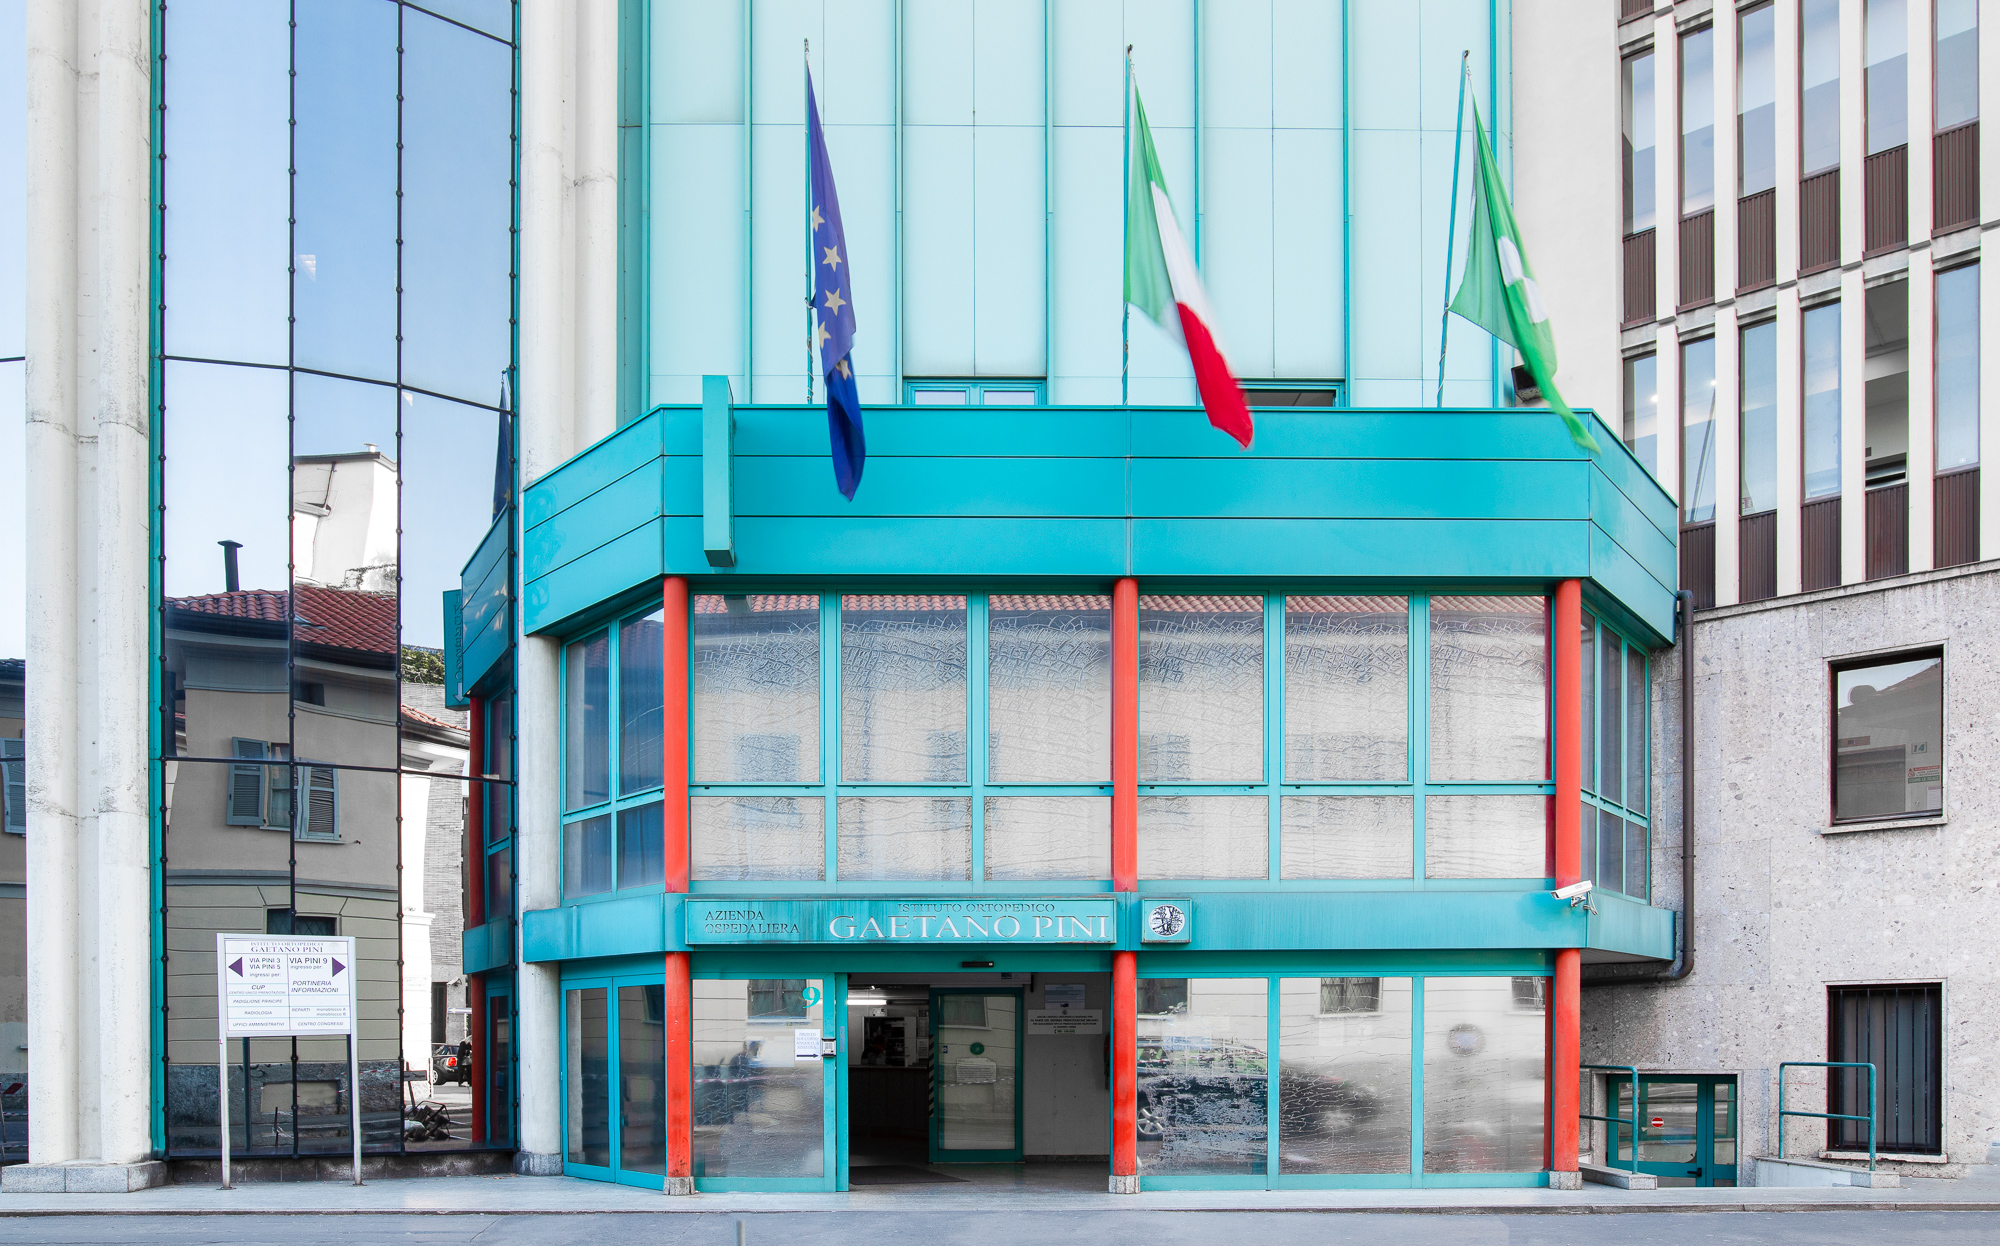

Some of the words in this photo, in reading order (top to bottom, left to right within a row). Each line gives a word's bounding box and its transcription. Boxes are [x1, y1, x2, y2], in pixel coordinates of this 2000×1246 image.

[1913, 744, 1925, 752] 14
[898, 903, 962, 913] ISTITUTO
[966, 903, 1055, 913] ORTOPEDICO
[705, 910, 765, 921] AZIENDA
[704, 923, 800, 934] OSPEDALIERA
[829, 915, 1021, 938] GAETANO
[1033, 915, 1110, 938] PINI
[802, 986, 821, 1009] 9
